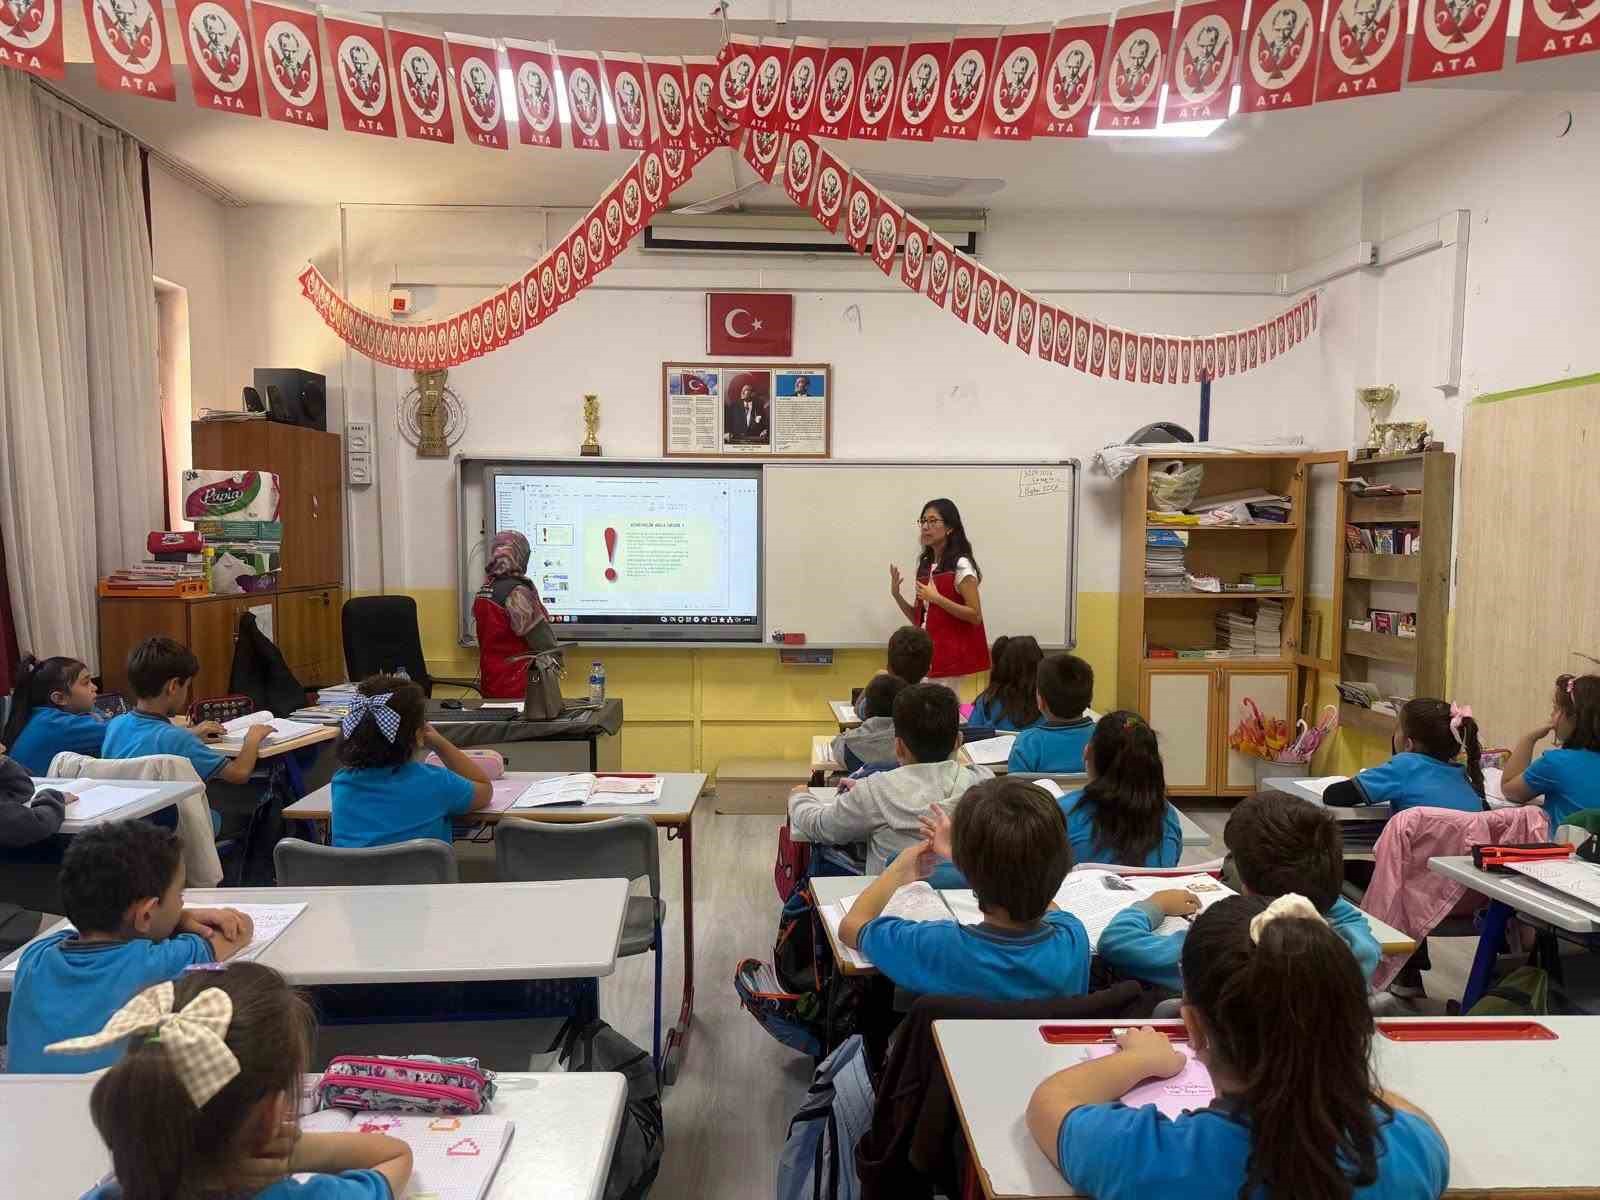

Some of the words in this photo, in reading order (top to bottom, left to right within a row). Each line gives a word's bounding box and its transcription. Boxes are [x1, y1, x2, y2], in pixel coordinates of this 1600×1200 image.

[1543, 32, 1593, 52] ATA
[0, 47, 41, 69] ATA
[1432, 56, 1476, 73] ATA
[120, 76, 157, 94] ATA
[1337, 78, 1377, 94] ATA
[213, 95, 244, 110] ATA
[1256, 92, 1292, 107] ATA
[285, 108, 314, 123] ATA
[719, 105, 738, 119] ATA
[1179, 108, 1211, 119] ATA
[358, 119, 384, 132] ATA
[750, 119, 767, 129] ATA
[784, 122, 801, 131] ATA
[1111, 116, 1141, 127] ATA
[420, 125, 443, 138] ATA
[818, 125, 840, 135] ATA
[859, 126, 878, 136] ATA
[902, 127, 923, 137] ATA
[943, 125, 967, 135] ATA
[993, 126, 1019, 136] ATA
[1047, 123, 1073, 133] ATA
[478, 134, 498, 145] ATA
[532, 134, 551, 145] ATA
[582, 138, 600, 147] ATA
[628, 139, 644, 147] ATA
[669, 139, 683, 147] ATA
[752, 158, 764, 175] ATA
[203, 486, 243, 504] Papia
